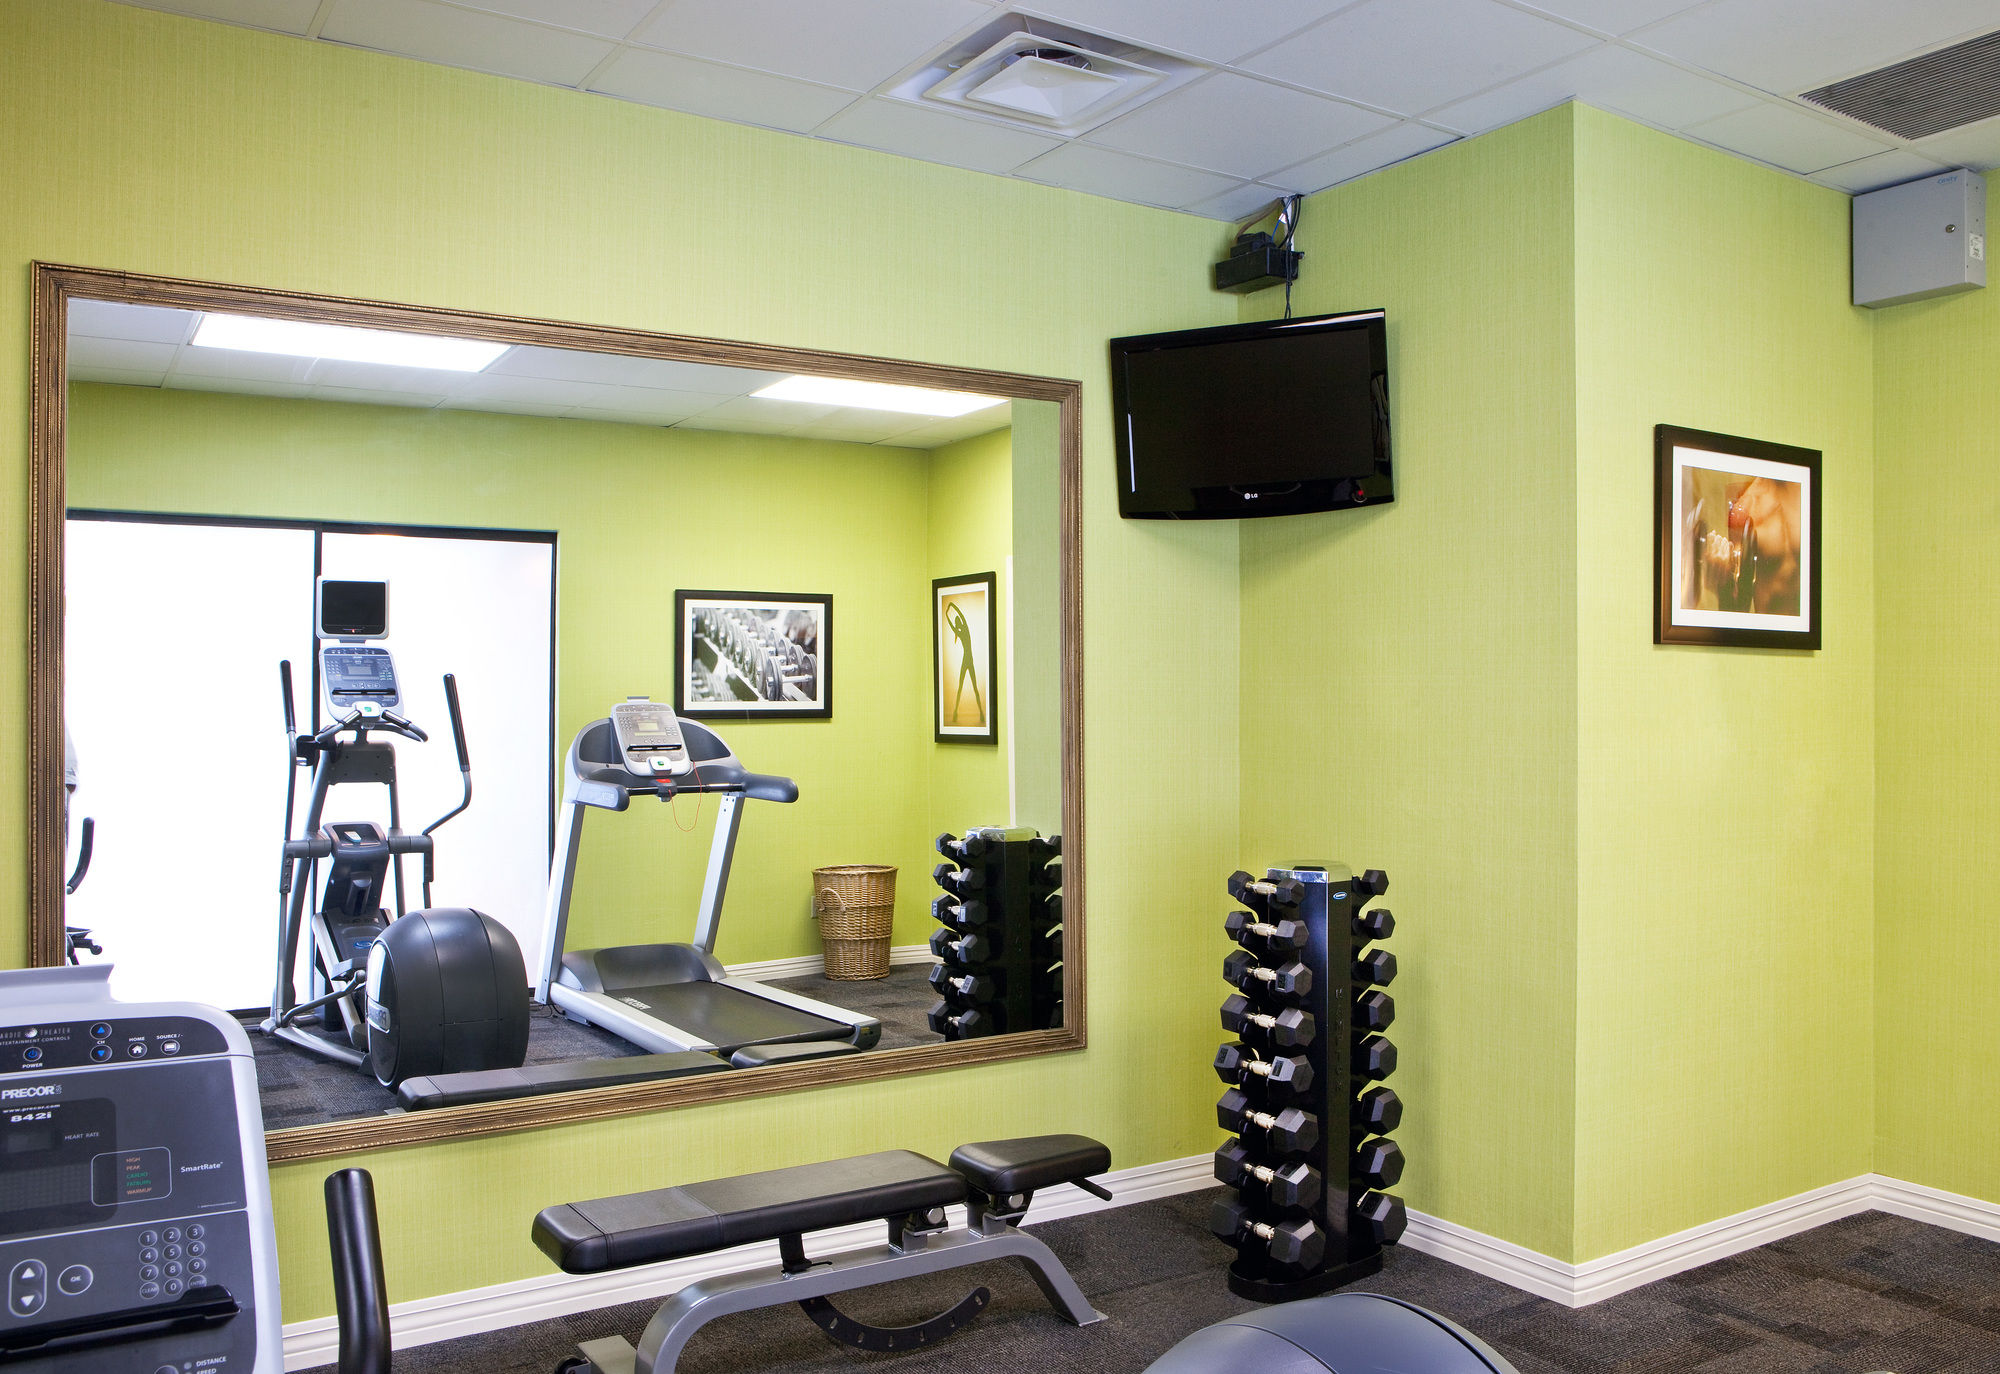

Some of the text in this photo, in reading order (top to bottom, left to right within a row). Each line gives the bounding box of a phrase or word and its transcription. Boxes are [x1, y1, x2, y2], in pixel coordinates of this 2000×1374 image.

[1, 1085, 55, 1100] PRECOR
[3, 1104, 60, 1113] www.precor.com
[10, 1112, 52, 1123] 842i
[64, 1131, 99, 1141] HEART RATE
[145, 1228, 198, 1243] 1 2 3
[145, 1244, 199, 1259] 4 5 6
[146, 1261, 200, 1278] 7 8 9
[170, 1282, 177, 1291] 0
[196, 1356, 227, 1367] DISTANCE
